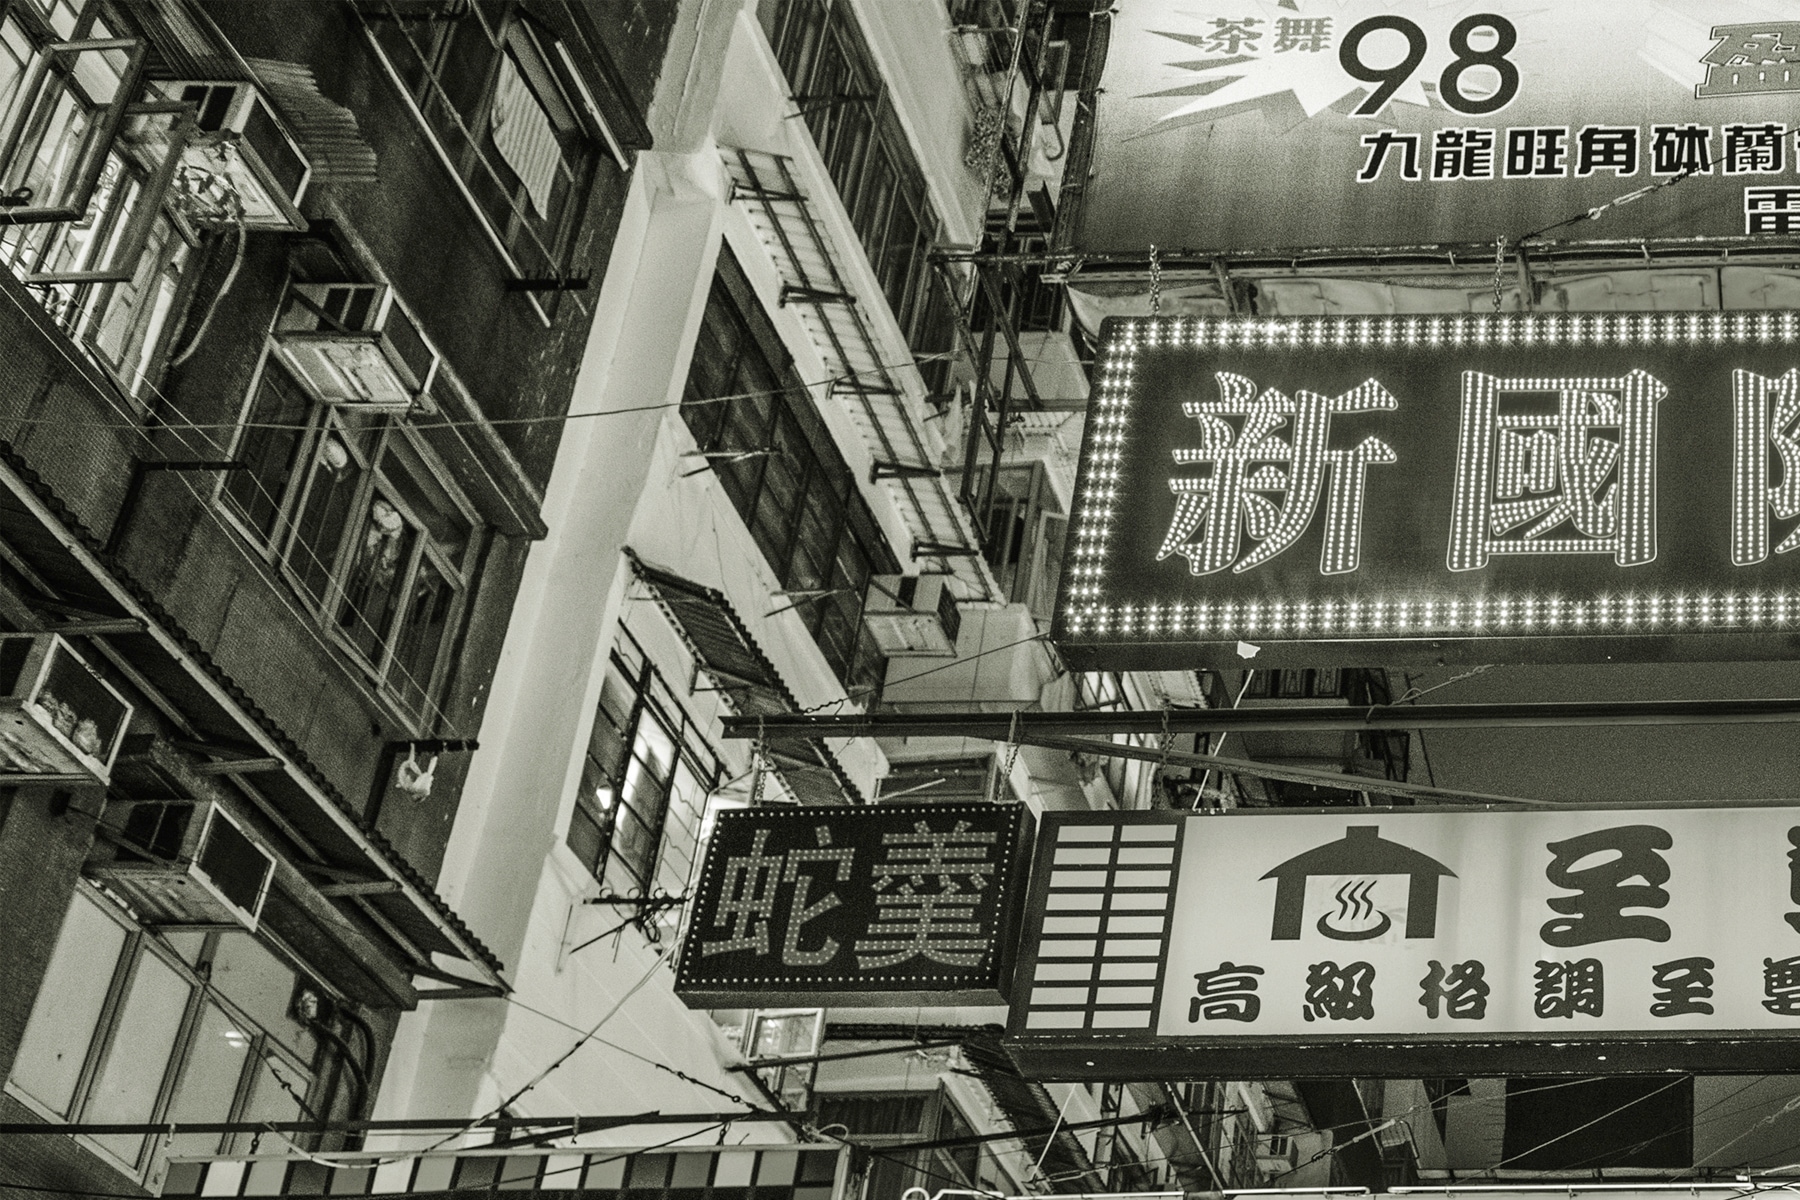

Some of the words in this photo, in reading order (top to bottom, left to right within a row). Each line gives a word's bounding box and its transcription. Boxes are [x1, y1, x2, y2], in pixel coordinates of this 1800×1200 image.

[1206, 12, 1334, 56] 茶舞
[1337, 13, 1519, 117] 98
[701, 820, 999, 969] 蛇羹
